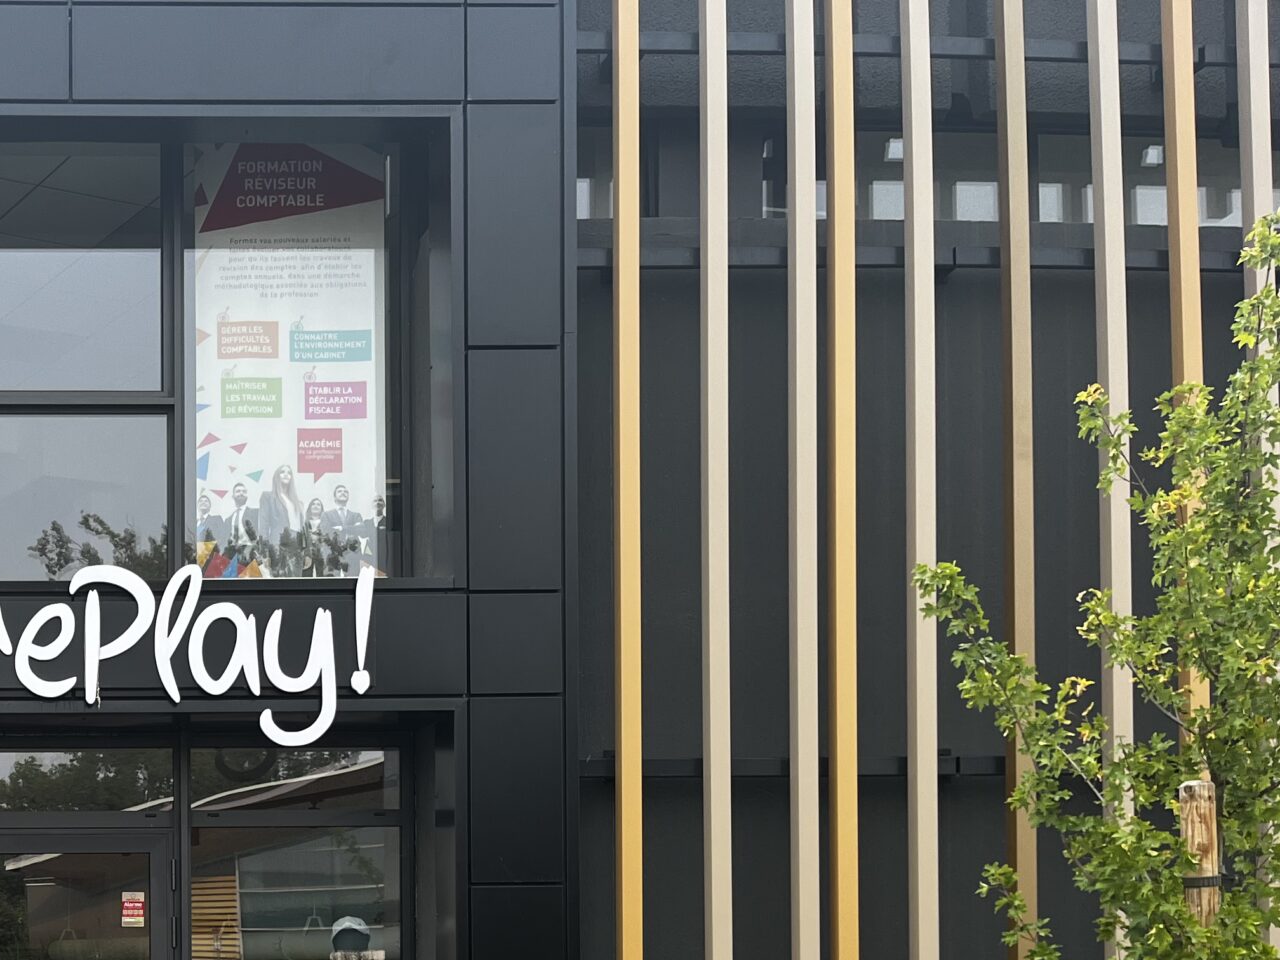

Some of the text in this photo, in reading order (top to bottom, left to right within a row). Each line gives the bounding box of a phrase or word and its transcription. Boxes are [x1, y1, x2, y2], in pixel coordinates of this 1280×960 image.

[238, 160, 322, 174] FORMATION
[244, 175, 316, 191] RÉVISEUR
[236, 193, 325, 208] COMPTABLE
[221, 335, 270, 344] DIFFICULTÉS
[221, 345, 273, 354] COMPTABLES
[294, 341, 367, 349] L'ENVIRONNEMENT
[294, 351, 346, 360] D'UN CABINET
[308, 385, 353, 395] ÉTABLIR LA
[225, 393, 277, 402] LES TRAVAUX
[308, 396, 363, 405] DÉCLARATION
[225, 404, 273, 414] DE RÉVISION
[308, 406, 341, 414] FISCALE
[298, 438, 342, 448] ACADÉMIE
